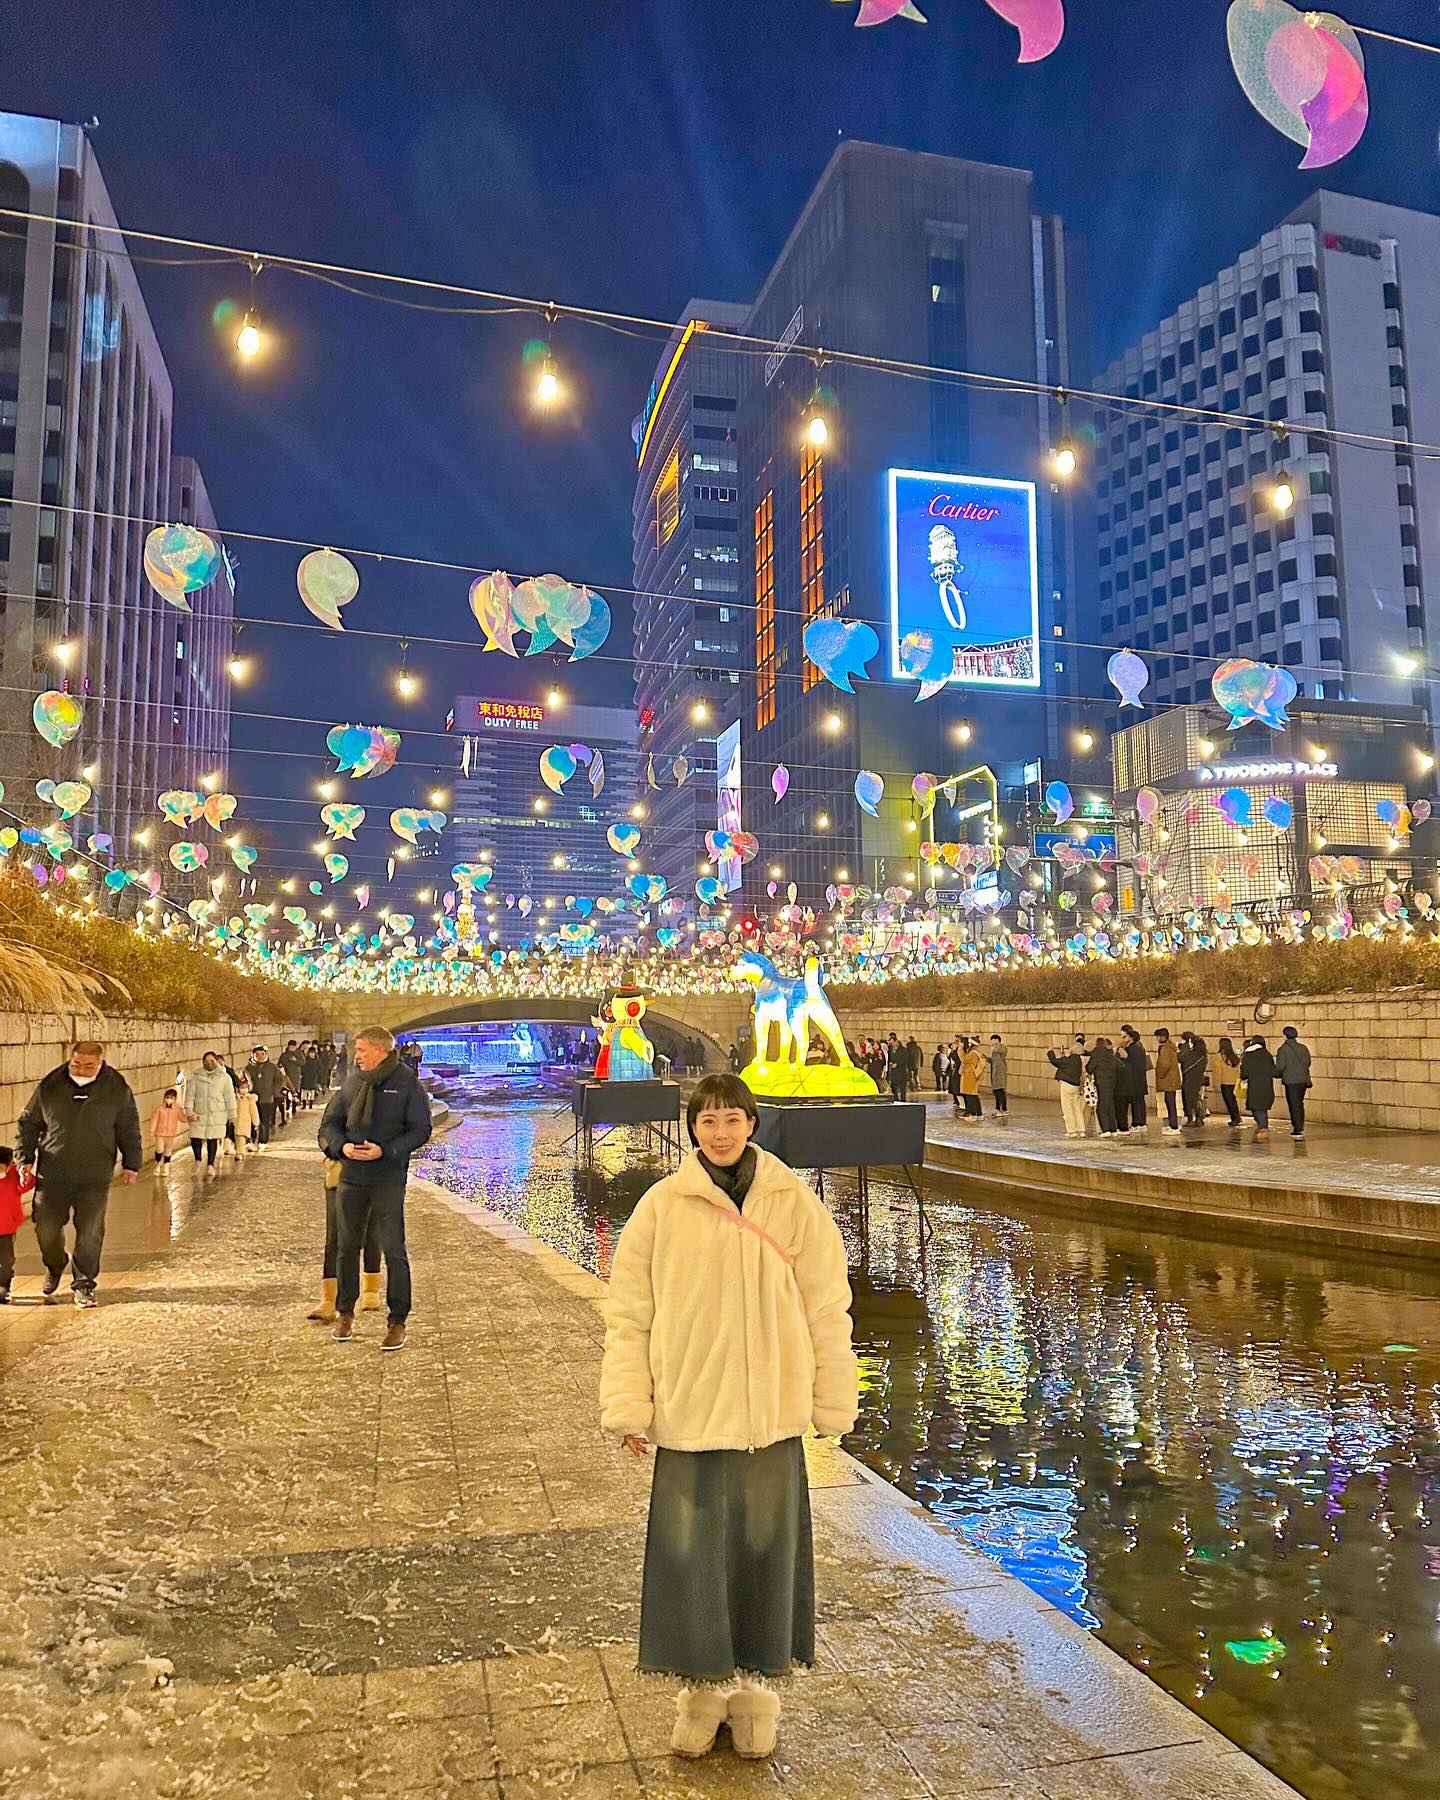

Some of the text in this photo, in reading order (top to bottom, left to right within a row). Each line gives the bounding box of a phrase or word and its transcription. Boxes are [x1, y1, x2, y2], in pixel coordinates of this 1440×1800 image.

[928, 494, 1000, 521] Cartier
[484, 716, 540, 730] DUTY FREE
[1295, 761, 1339, 776] PLACE
